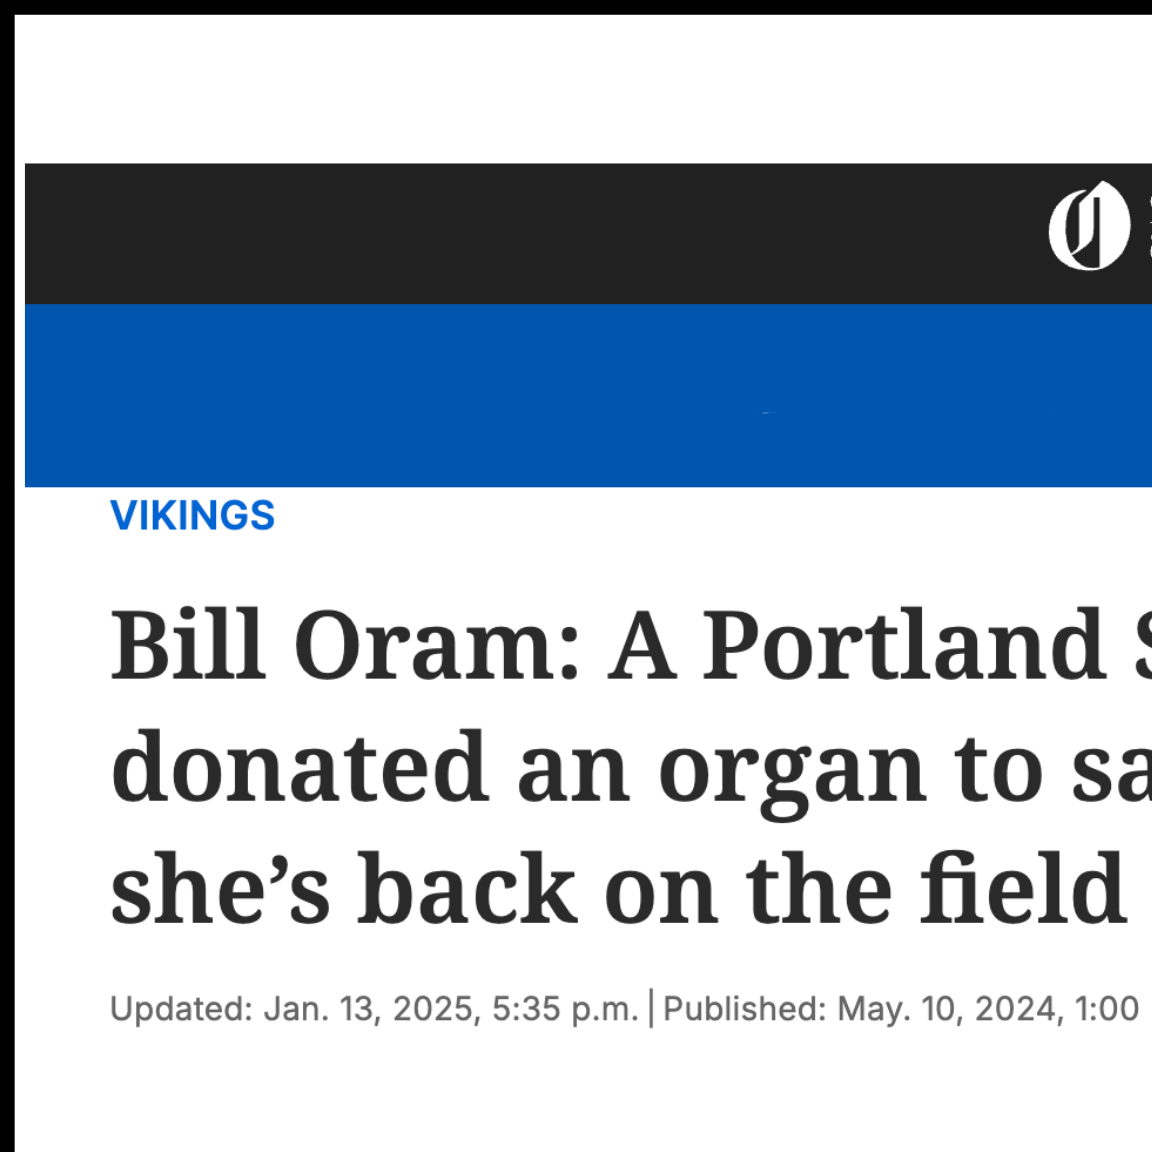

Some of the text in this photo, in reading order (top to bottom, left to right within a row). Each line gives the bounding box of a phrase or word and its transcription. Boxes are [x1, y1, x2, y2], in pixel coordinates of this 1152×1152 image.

[110, 499, 274, 531] VIKINGS
[111, 606, 266, 679] Bill
[296, 609, 577, 680] Oram:
[607, 610, 678, 679] A
[703, 606, 1107, 680] Portland
[113, 728, 490, 802] donated
[519, 748, 630, 802] an
[660, 745, 927, 823] organ
[954, 737, 1042, 802] to
[112, 849, 1128, 924] she’s back on the field
[111, 995, 251, 1028] Updated:
[264, 995, 328, 1021] Jan.
[341, 995, 380, 1026] 13,
[394, 995, 480, 1026] 2025,
[494, 995, 560, 1021] 5:35
[573, 1001, 638, 1028] p.m.
[665, 995, 825, 1021] Published:
[839, 995, 910, 1028] May.
[922, 995, 962, 1026] 10,
[976, 995, 1063, 1026] 2024,
[1076, 995, 1139, 1021] 1:00
